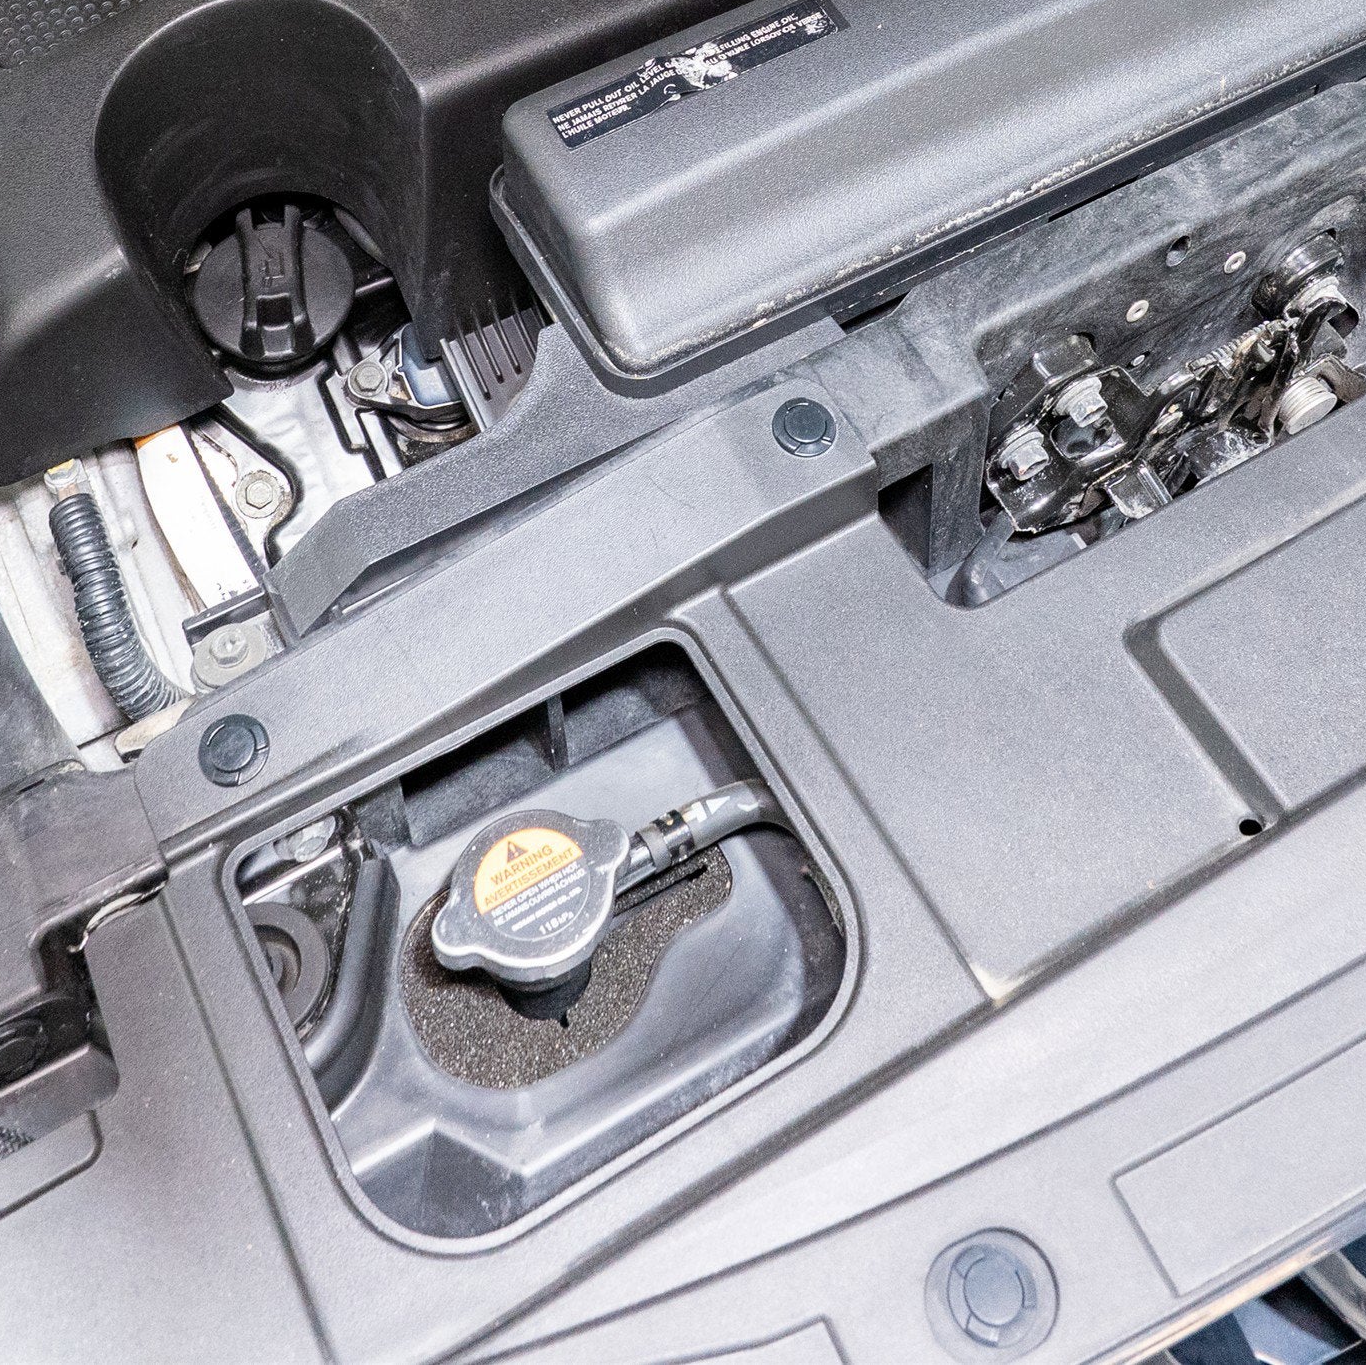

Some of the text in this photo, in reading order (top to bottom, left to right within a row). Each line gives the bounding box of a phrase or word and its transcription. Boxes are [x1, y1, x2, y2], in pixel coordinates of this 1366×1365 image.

[552, 108, 582, 124] NEVER
[582, 98, 604, 112] PULL
[605, 88, 622, 103] OUT
[624, 82, 640, 94] OIL
[640, 64, 664, 84] LEVEL
[751, 20, 781, 37] ENGINE
[557, 122, 571, 132] NE
[572, 108, 602, 126] JAMAIS
[639, 85, 650, 96] LA
[650, 69, 676, 87] JAUGE
[561, 120, 594, 139] L'HUILE
[485, 847, 574, 907] AVERTISSEMENT
[490, 844, 553, 885] WARNING
[491, 897, 517, 918] NEVER
[517, 885, 539, 903] OPEN
[537, 871, 562, 890] WHEN
